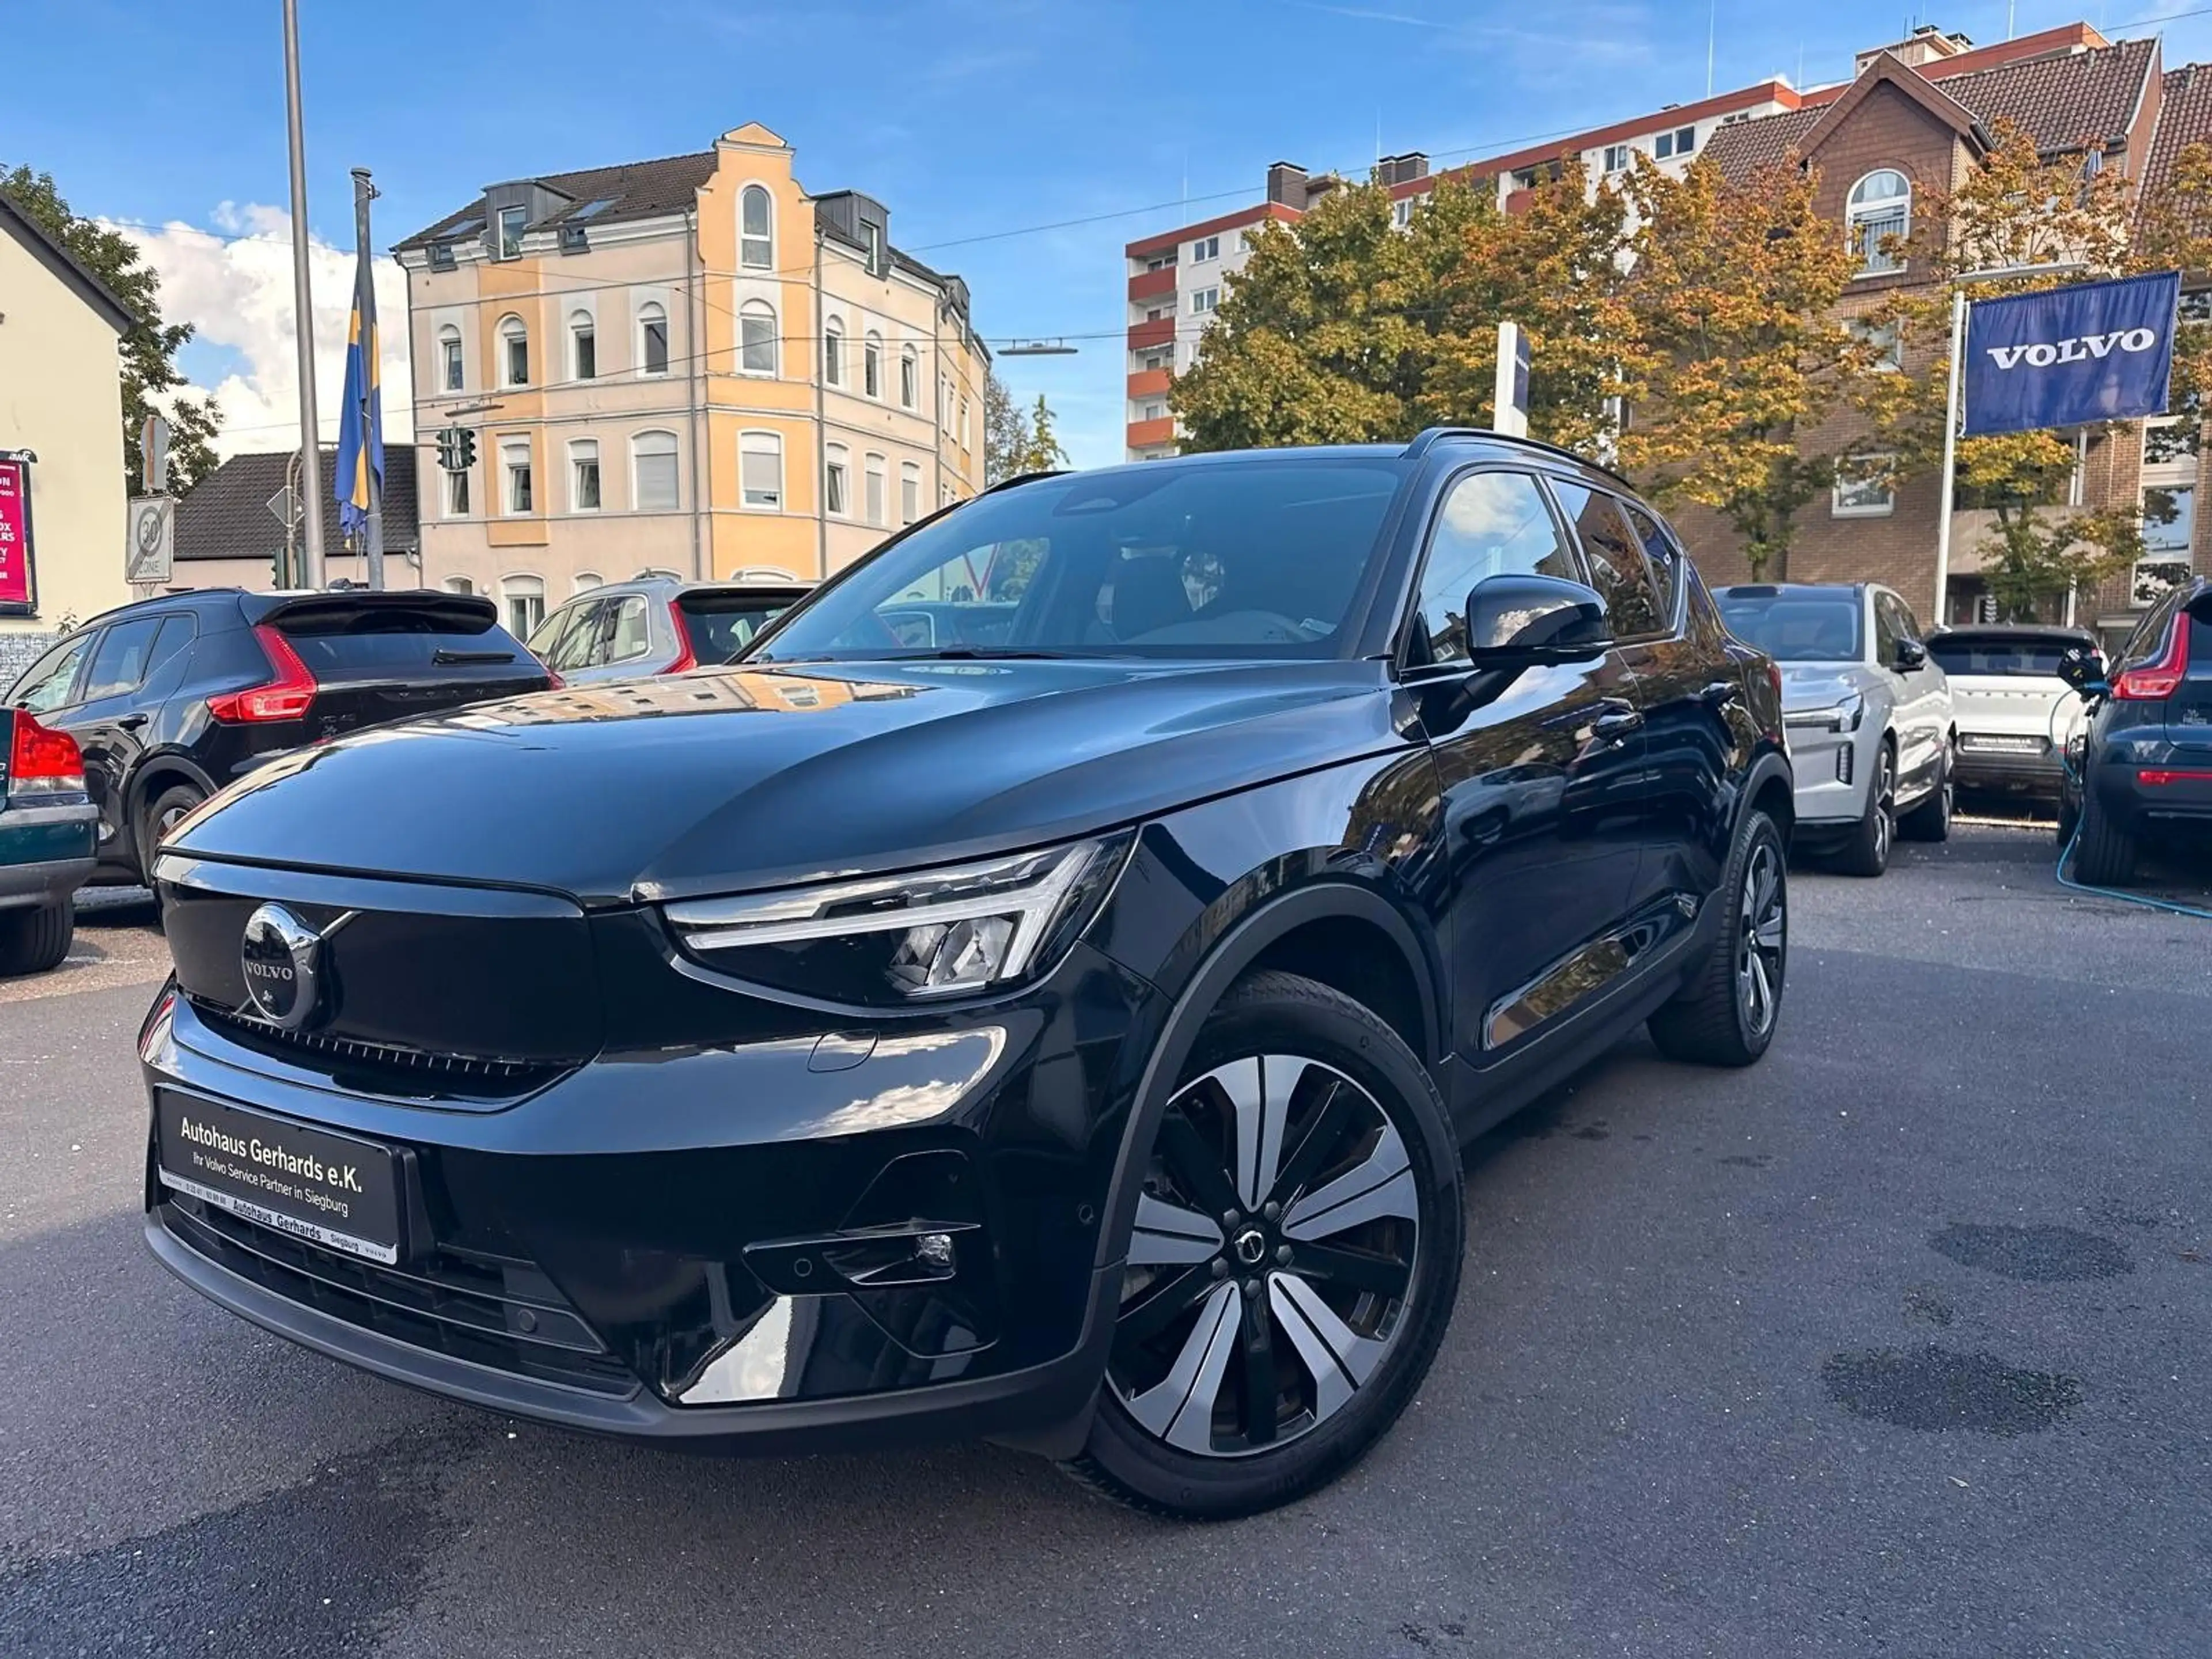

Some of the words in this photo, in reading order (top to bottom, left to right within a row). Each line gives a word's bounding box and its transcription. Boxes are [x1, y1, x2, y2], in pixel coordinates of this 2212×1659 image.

[1987, 328, 2155, 369] VOLVO
[143, 521, 157, 542] 30
[246, 962, 293, 980] VOLVO
[181, 1116, 247, 1157] Autohaus
[250, 1139, 323, 1181] Gerhards
[327, 1165, 363, 1192] e.K.
[193, 1152, 203, 1166] Ihr
[204, 1155, 226, 1175] Volvo
[228, 1163, 258, 1186] Service
[260, 1173, 293, 1196] Partner
[294, 1185, 303, 1199] in
[305, 1188, 349, 1217] Siegburg
[233, 1199, 273, 1223] Autohaus
[276, 1215, 321, 1240] Gerhards
[330, 1233, 359, 1252] Siegburg
